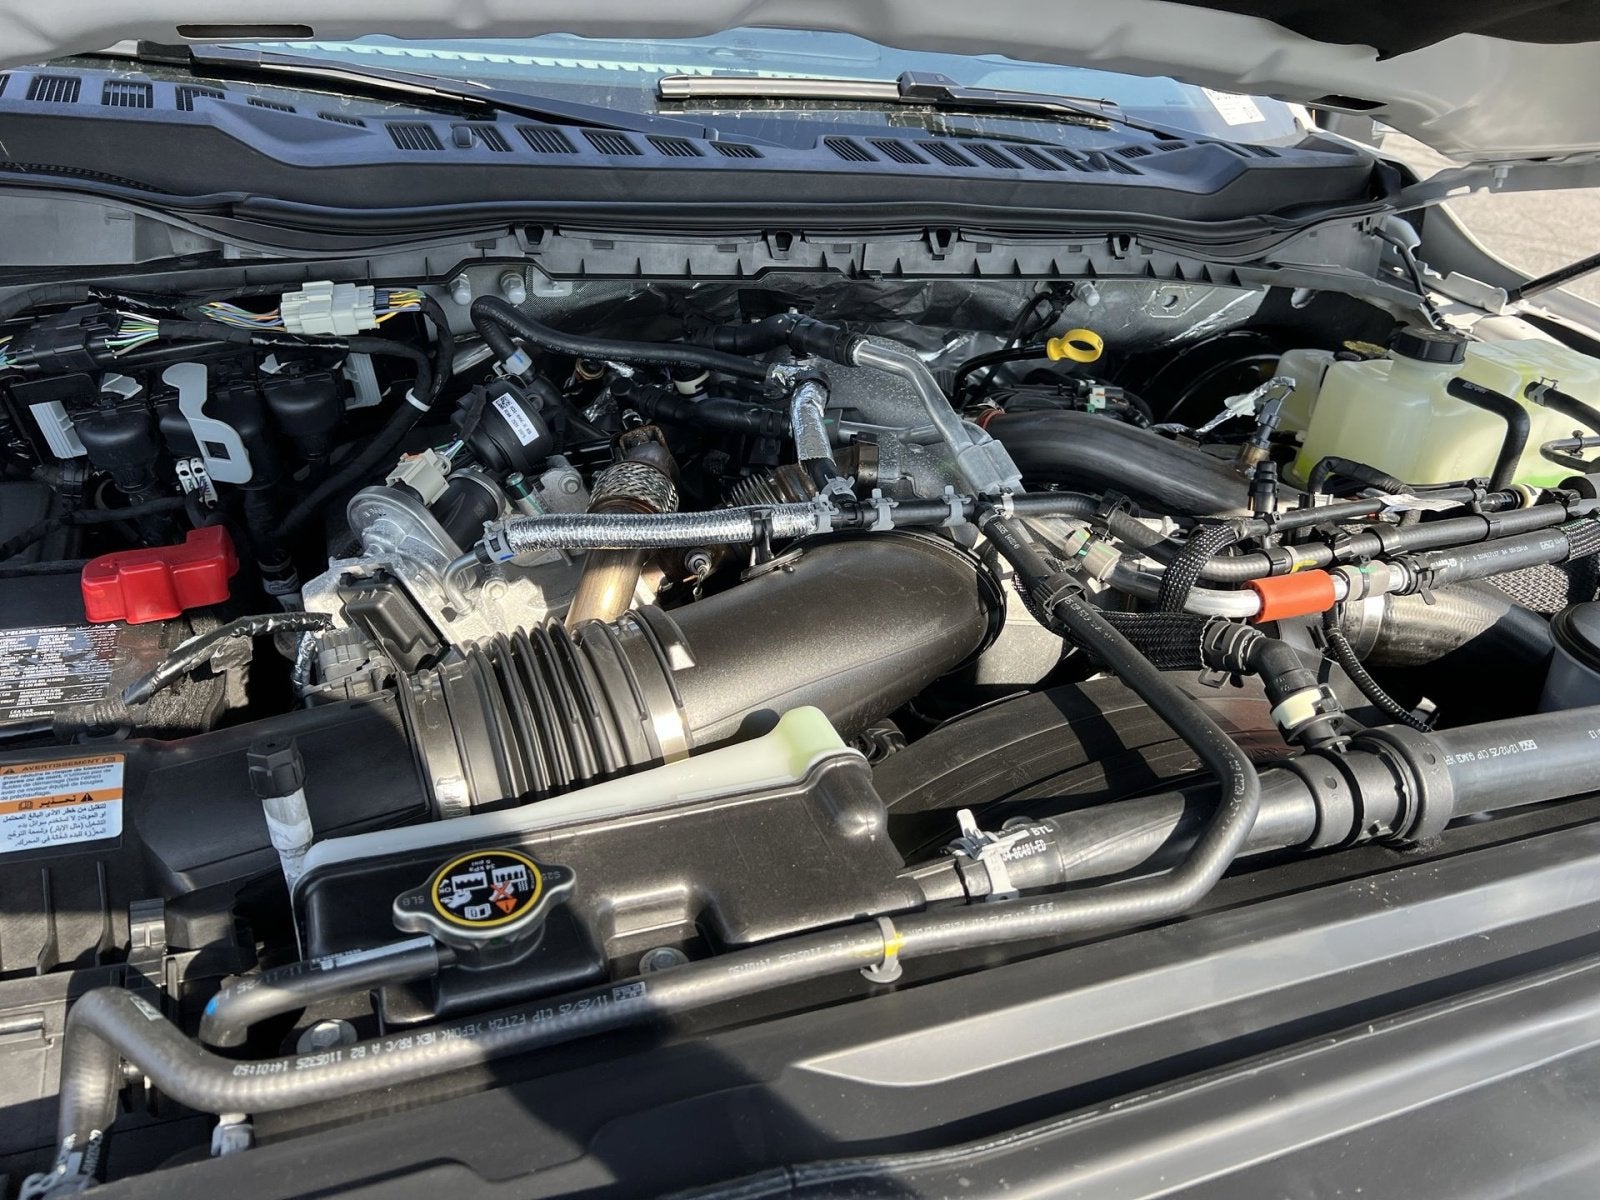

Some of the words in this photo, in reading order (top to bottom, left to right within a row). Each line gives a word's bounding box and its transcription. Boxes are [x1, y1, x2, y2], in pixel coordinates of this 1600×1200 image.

[22, 759, 101, 771] AVERTISSEMENT
[51, 769, 73, 777] risque
[49, 783, 69, 791] équipé
[80, 779, 104, 787] bougies
[9, 791, 51, 801] préchauffage.
[1029, 825, 1054, 836] BTL
[557, 994, 608, 1017] 11/25/25
[372, 1044, 380, 1055] A
